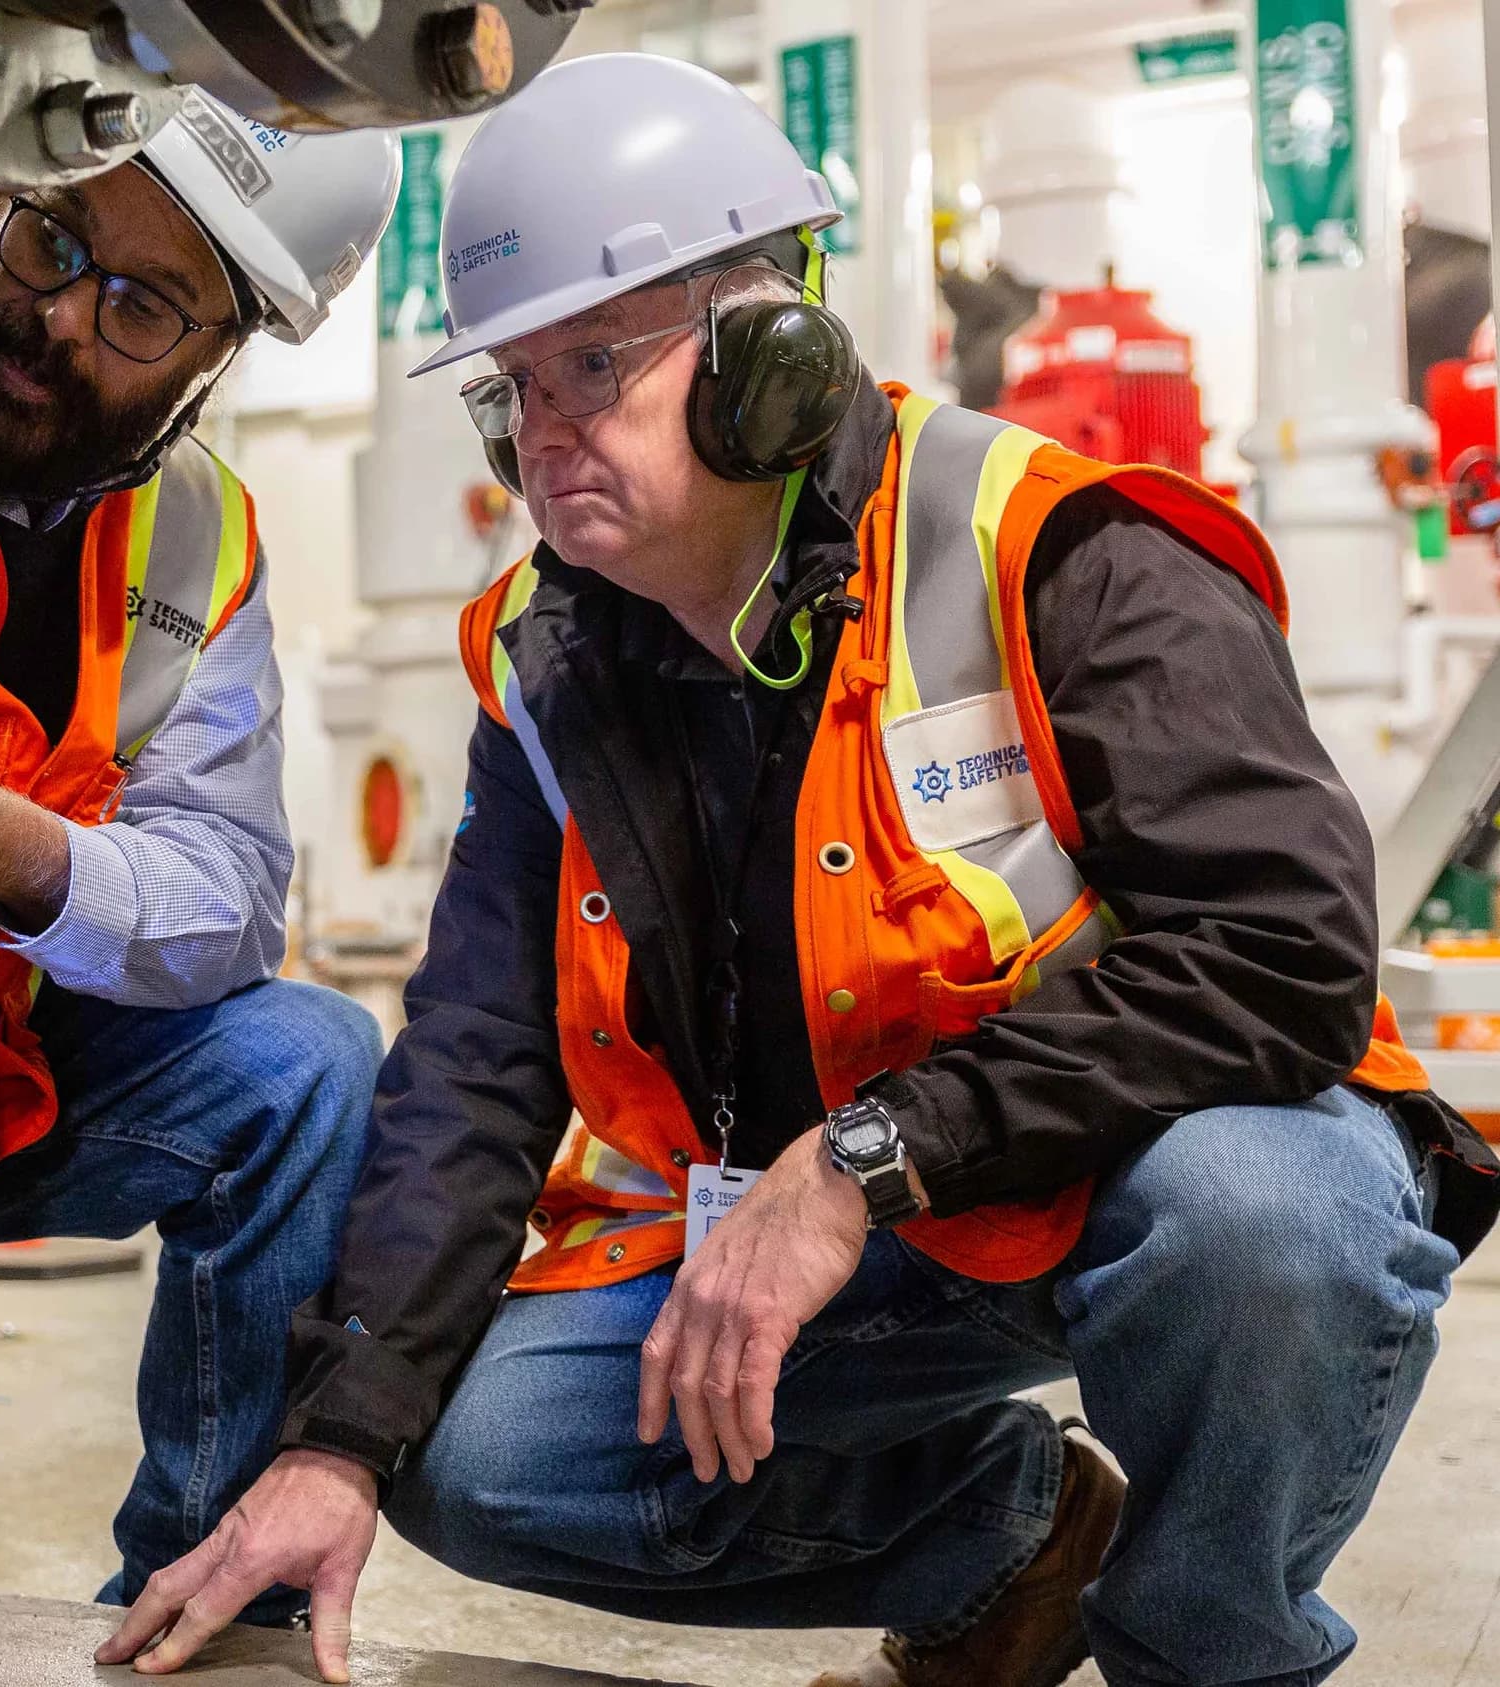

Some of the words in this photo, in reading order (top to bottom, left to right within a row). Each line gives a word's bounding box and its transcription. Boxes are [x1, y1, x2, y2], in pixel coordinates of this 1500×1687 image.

[256, 131, 276, 152] BC
[461, 229, 520, 260] TECHNICAL
[463, 248, 499, 272] SAFETY
[502, 242, 520, 257] BC
[149, 614, 200, 648] SAFETY
[154, 600, 207, 637] TECHNIC
[956, 744, 1026, 775] TECHNICA
[959, 761, 1014, 790] SAFETY
[1015, 759, 1030, 774] B
